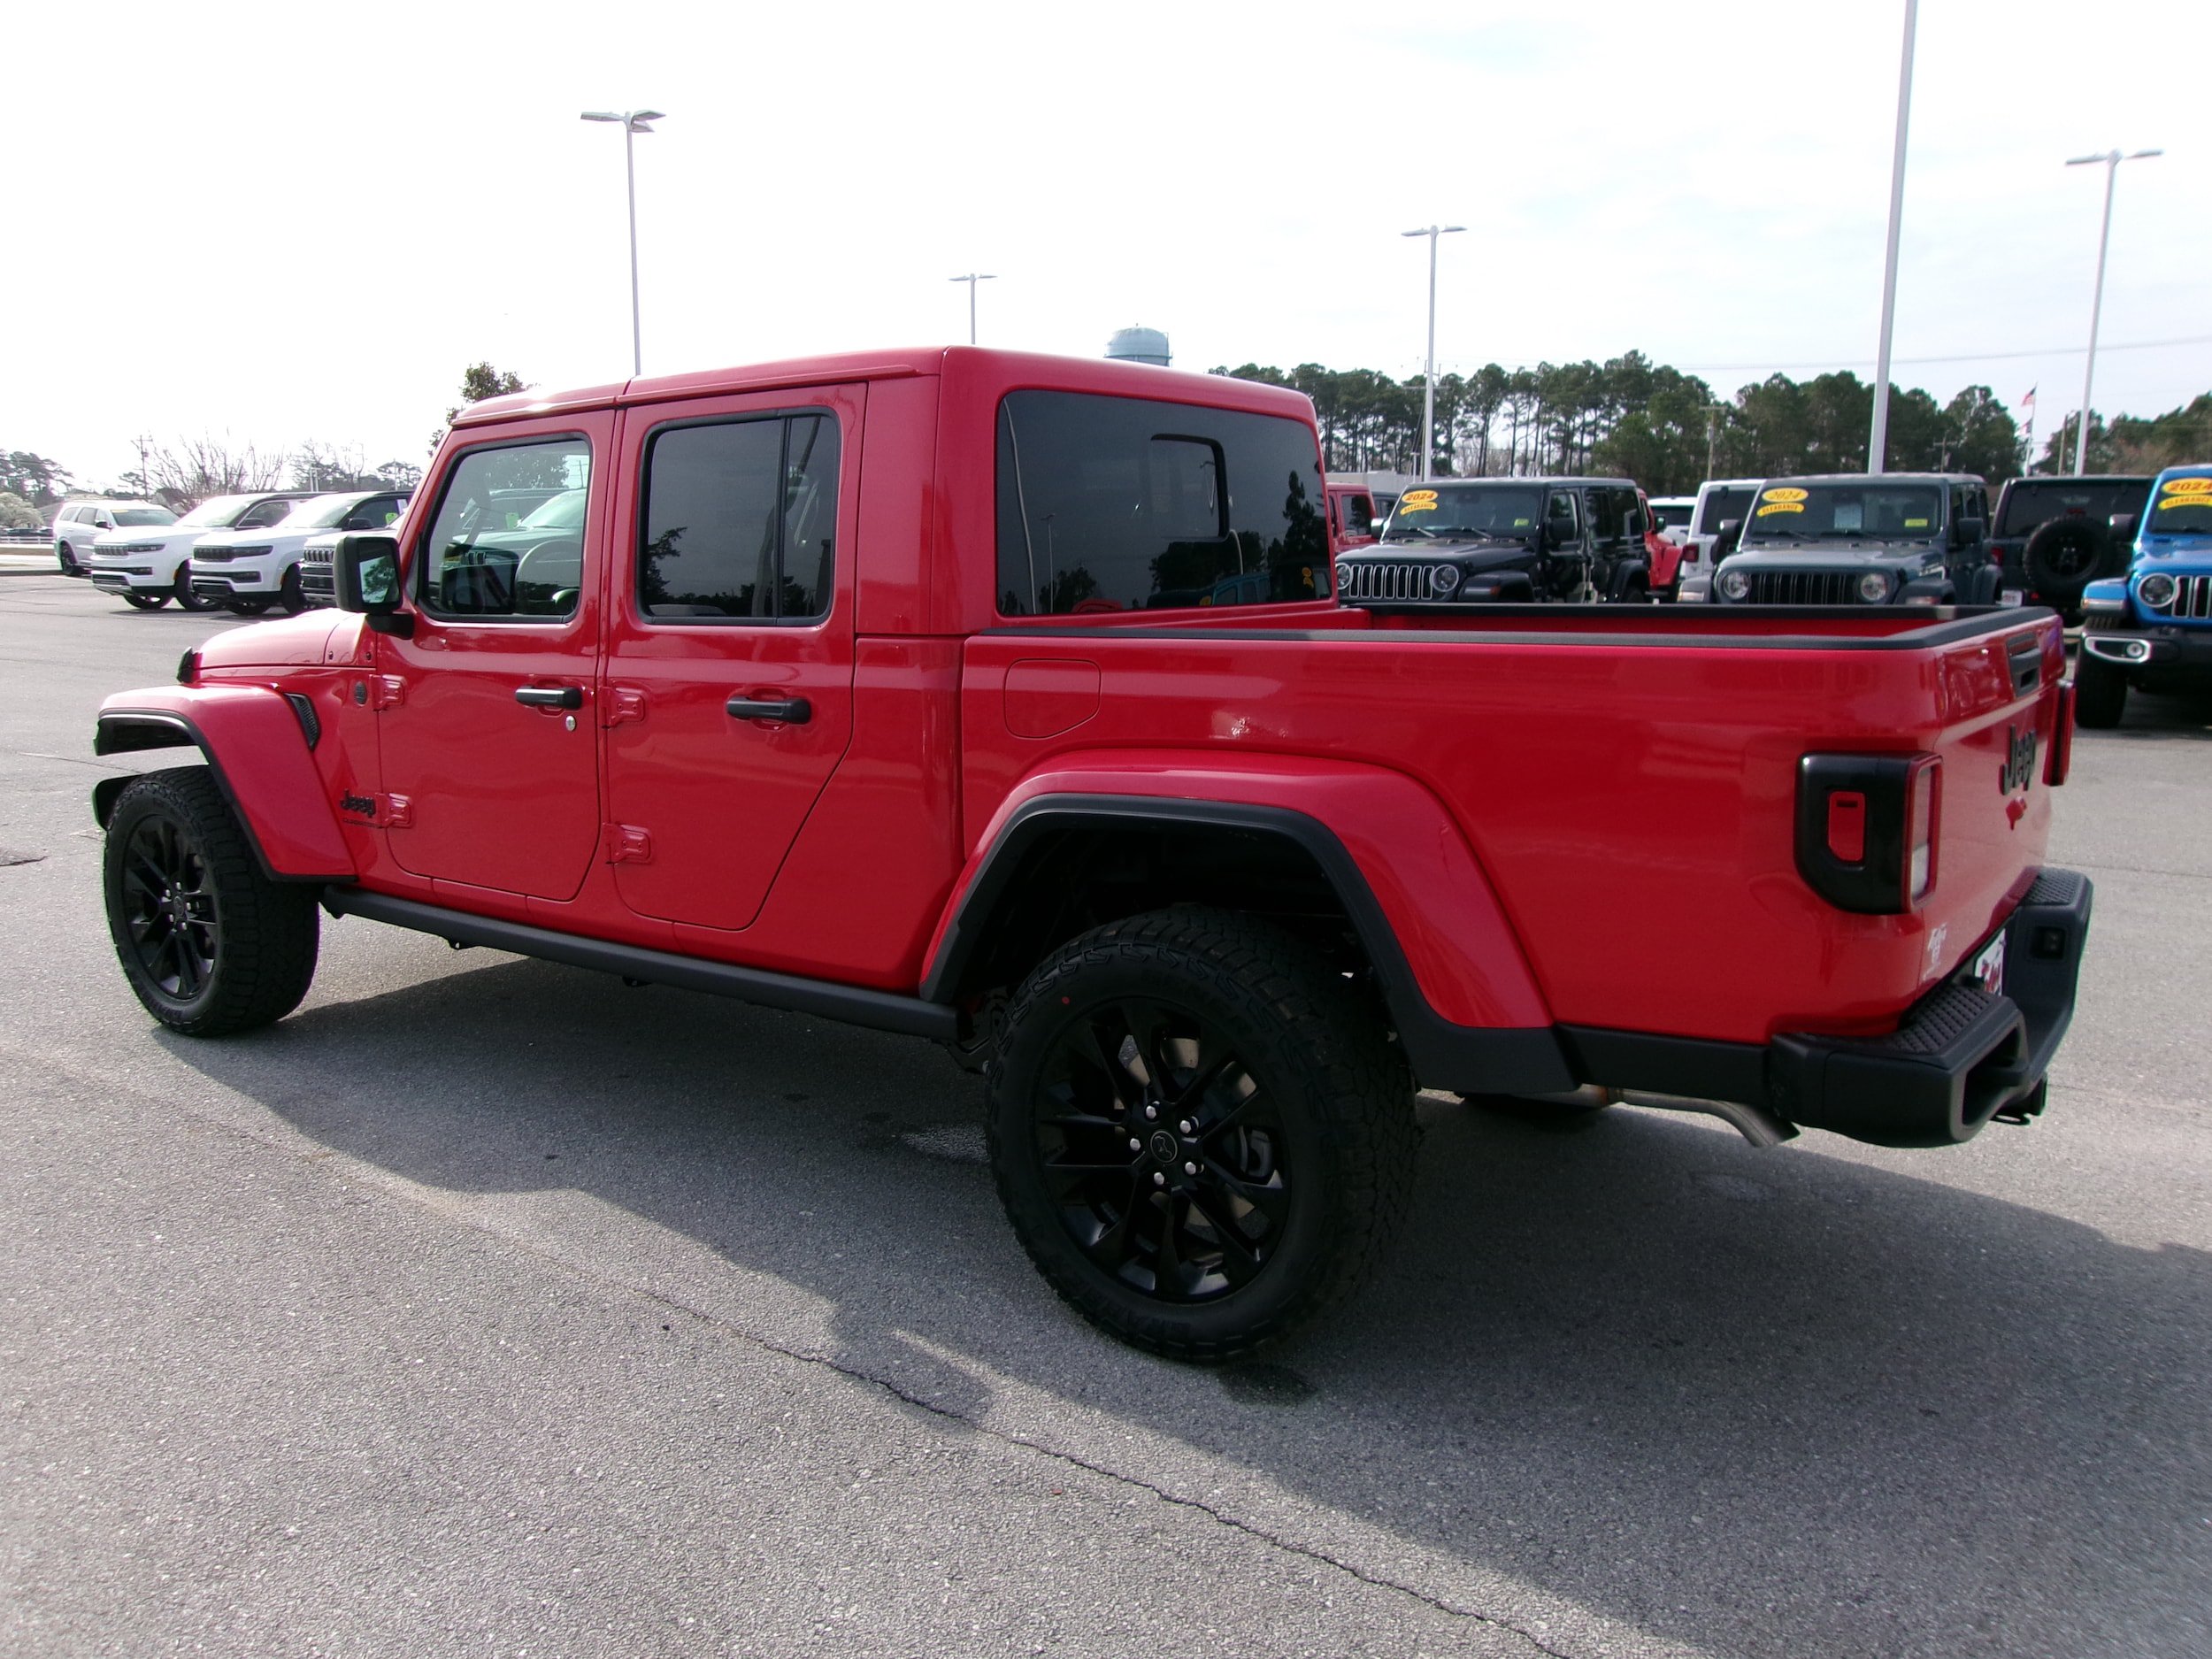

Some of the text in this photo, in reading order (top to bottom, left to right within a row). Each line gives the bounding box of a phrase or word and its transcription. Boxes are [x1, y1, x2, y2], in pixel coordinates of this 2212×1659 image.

[1405, 492, 1434, 501] 2024
[2000, 724, 2037, 795] Jeep
[340, 788, 376, 818] Jeep
